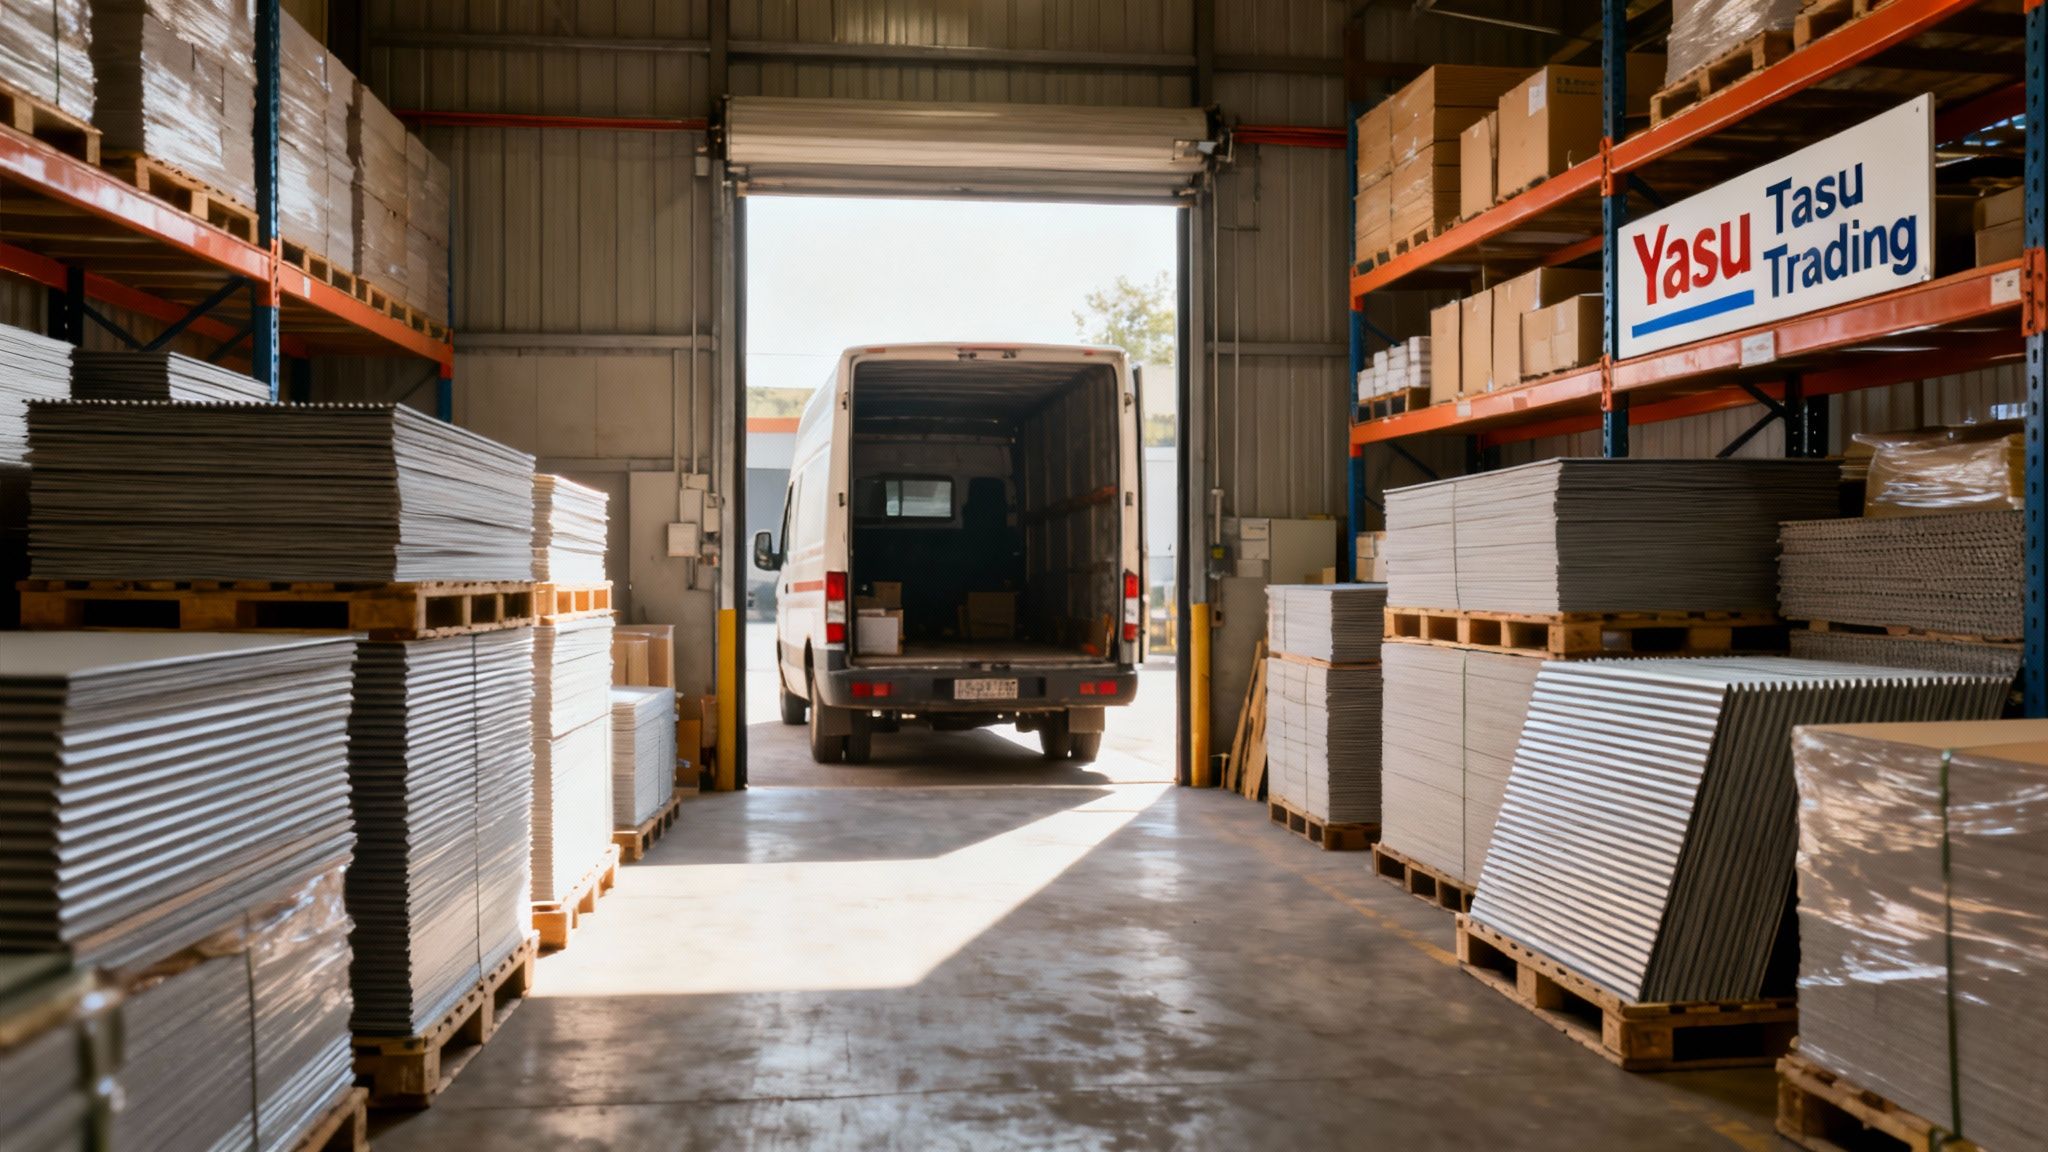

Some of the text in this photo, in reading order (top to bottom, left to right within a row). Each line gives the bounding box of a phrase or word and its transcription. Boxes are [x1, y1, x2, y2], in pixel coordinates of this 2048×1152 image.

[1766, 162, 1863, 235] Tasu
[1633, 213, 1751, 305] Yasu
[1763, 215, 1917, 298] Trading
